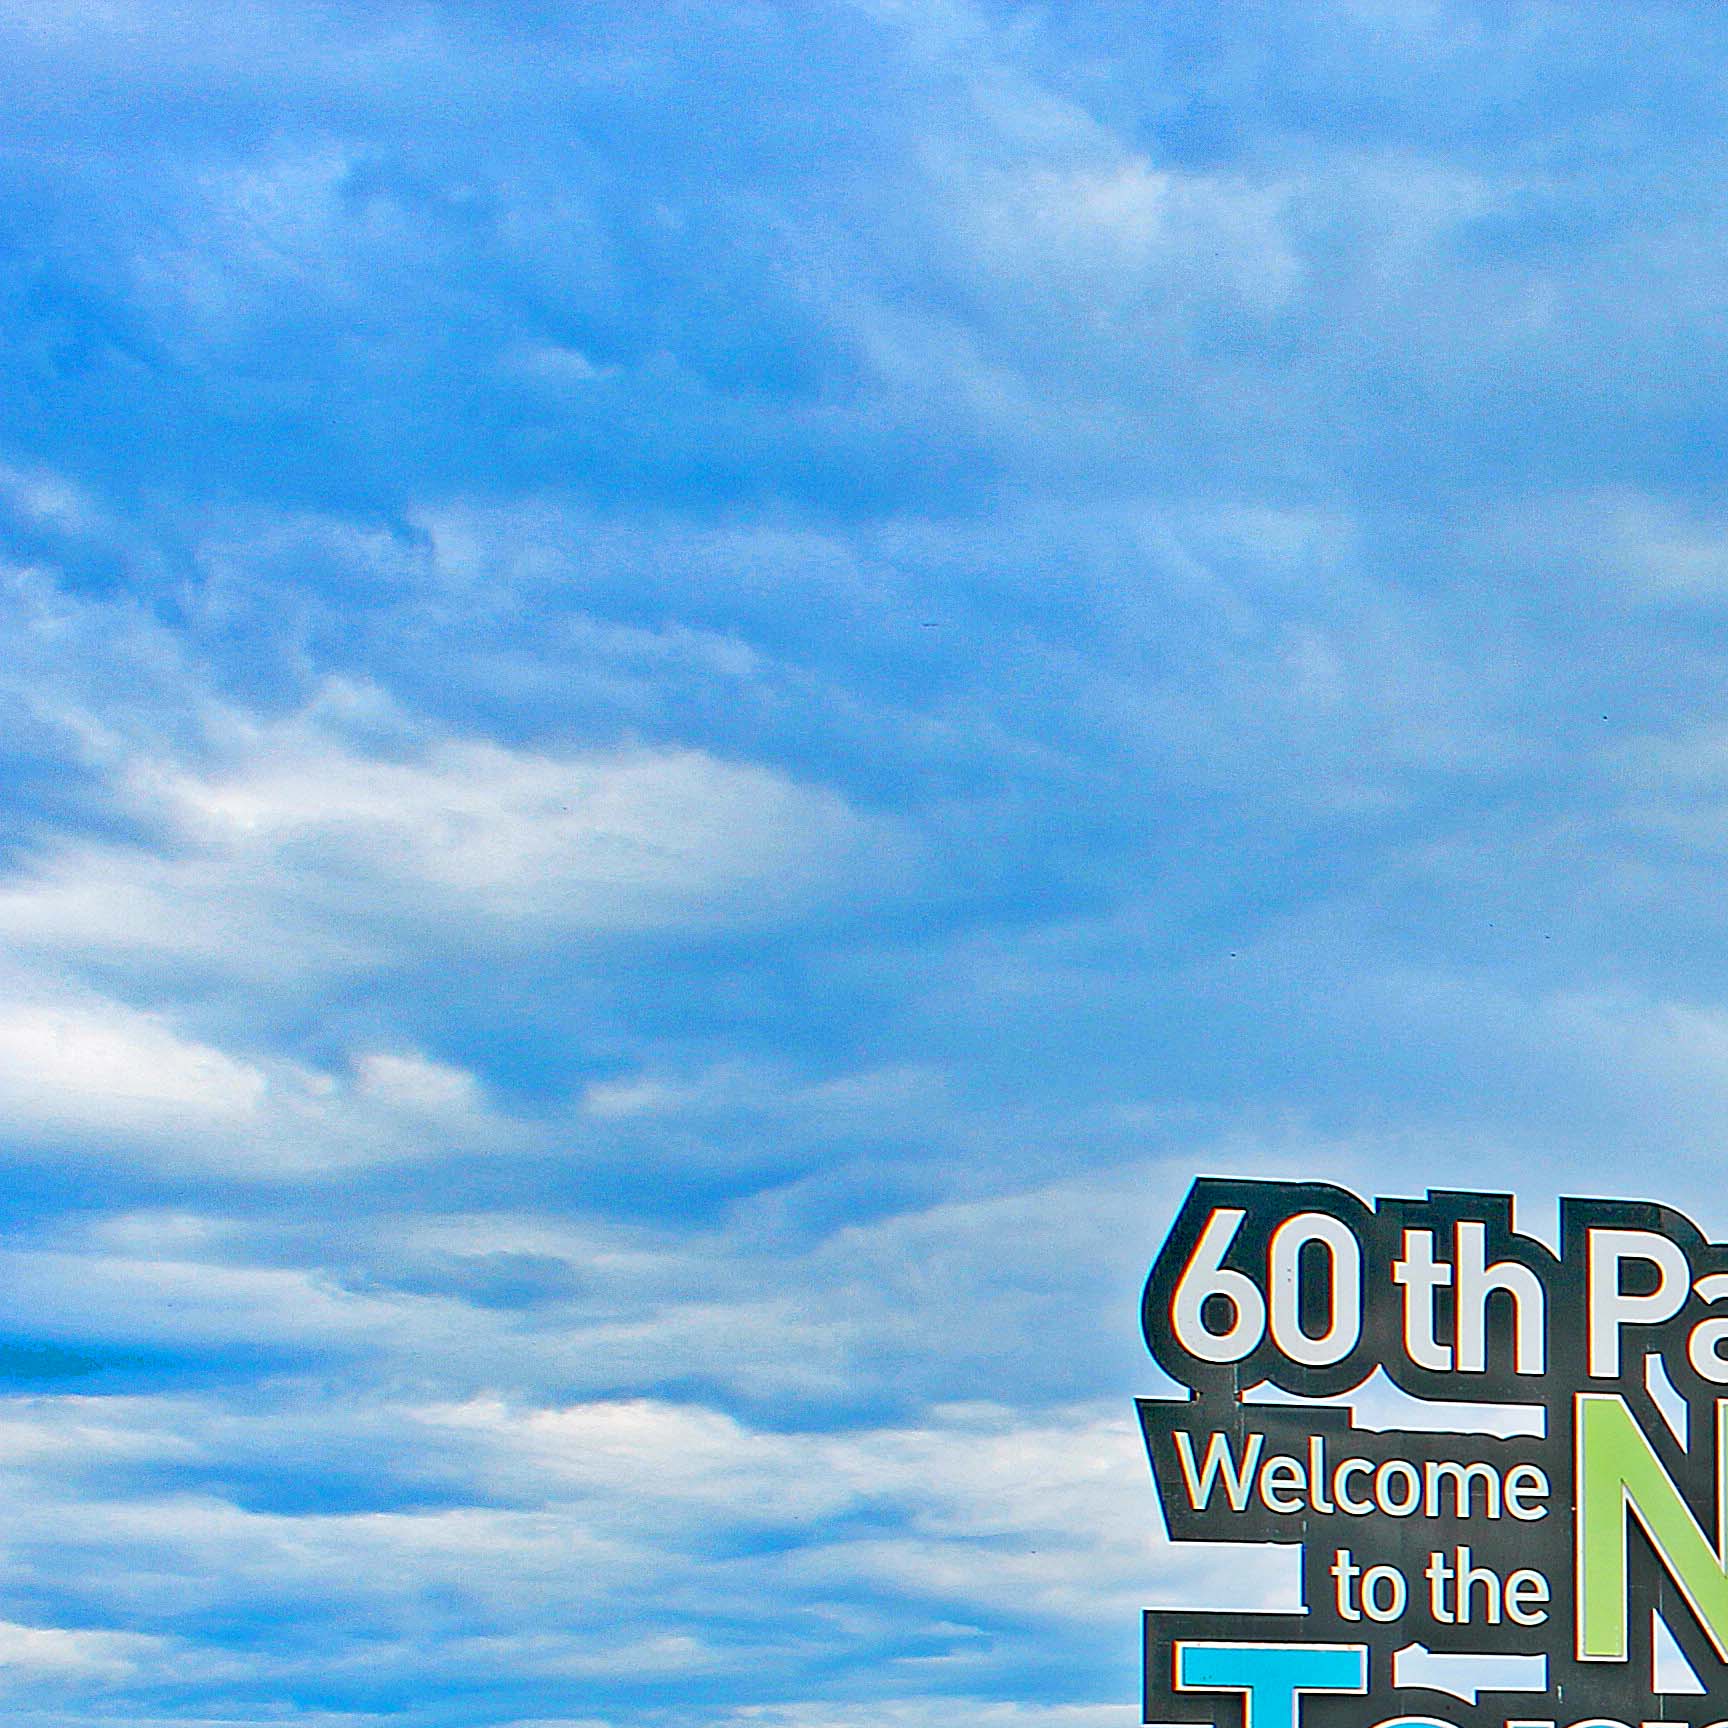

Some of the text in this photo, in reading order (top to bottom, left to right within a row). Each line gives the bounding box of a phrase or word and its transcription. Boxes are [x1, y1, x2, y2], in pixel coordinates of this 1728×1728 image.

[1173, 1430, 1550, 1522] Welcome
[1329, 1546, 1552, 1626] to the
